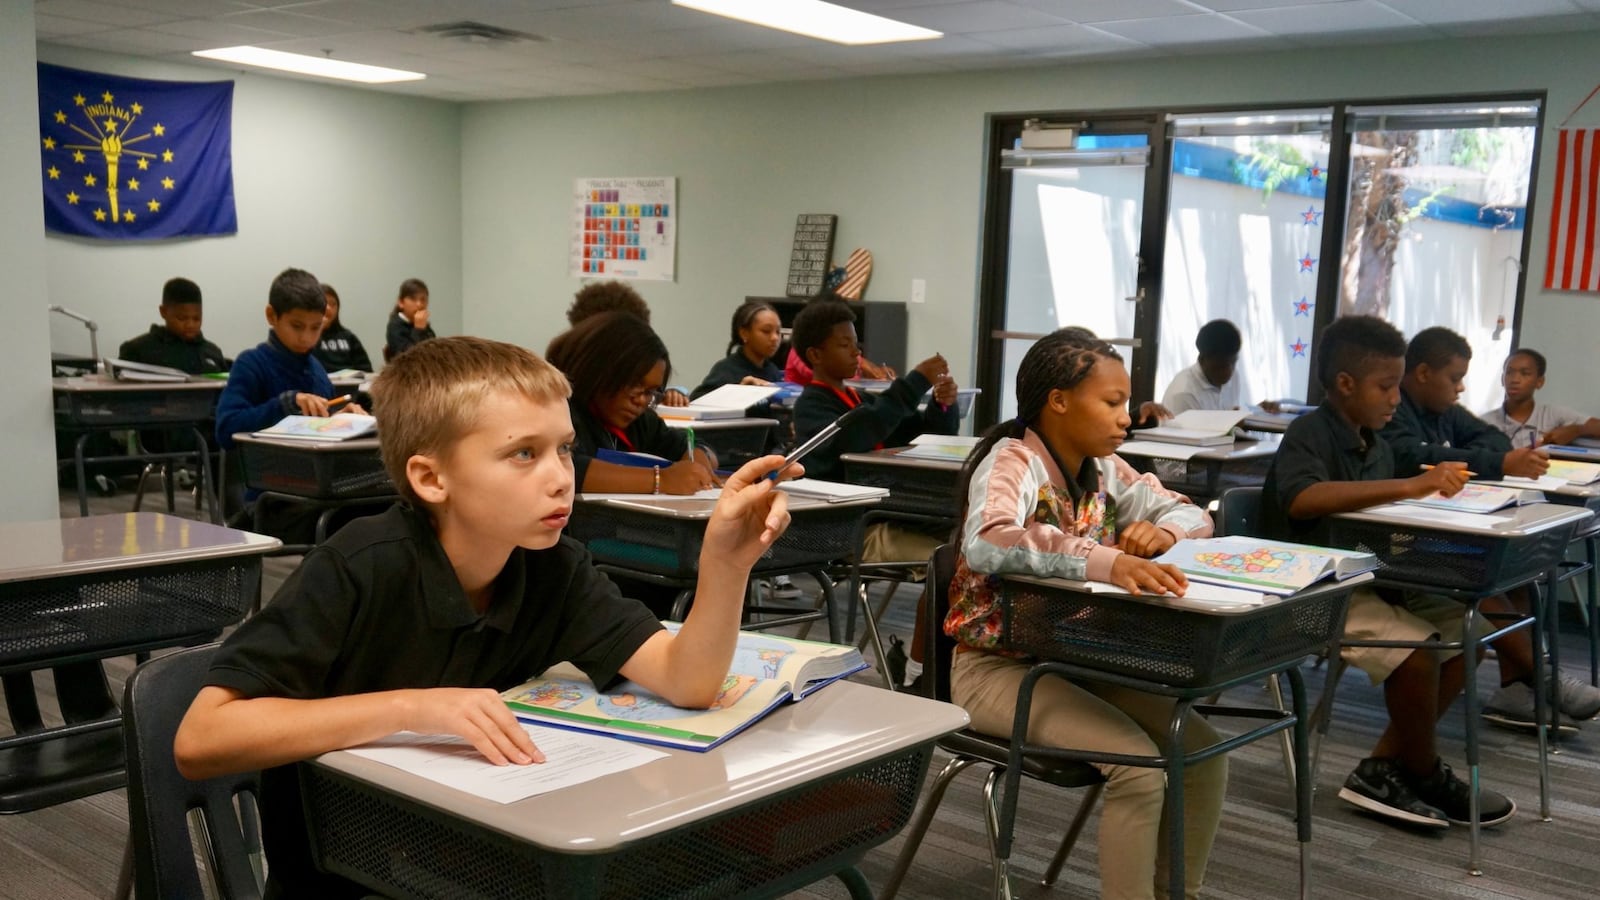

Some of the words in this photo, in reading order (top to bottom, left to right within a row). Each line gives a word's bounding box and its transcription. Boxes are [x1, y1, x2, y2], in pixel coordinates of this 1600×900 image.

[86, 104, 130, 122] INDIANA
[795, 232, 829, 241] ABSOLUTELY
[791, 250, 808, 260] ONLY
[808, 251, 826, 260] HUGS
[812, 262, 825, 271] AND
[787, 285, 807, 296] THANK
